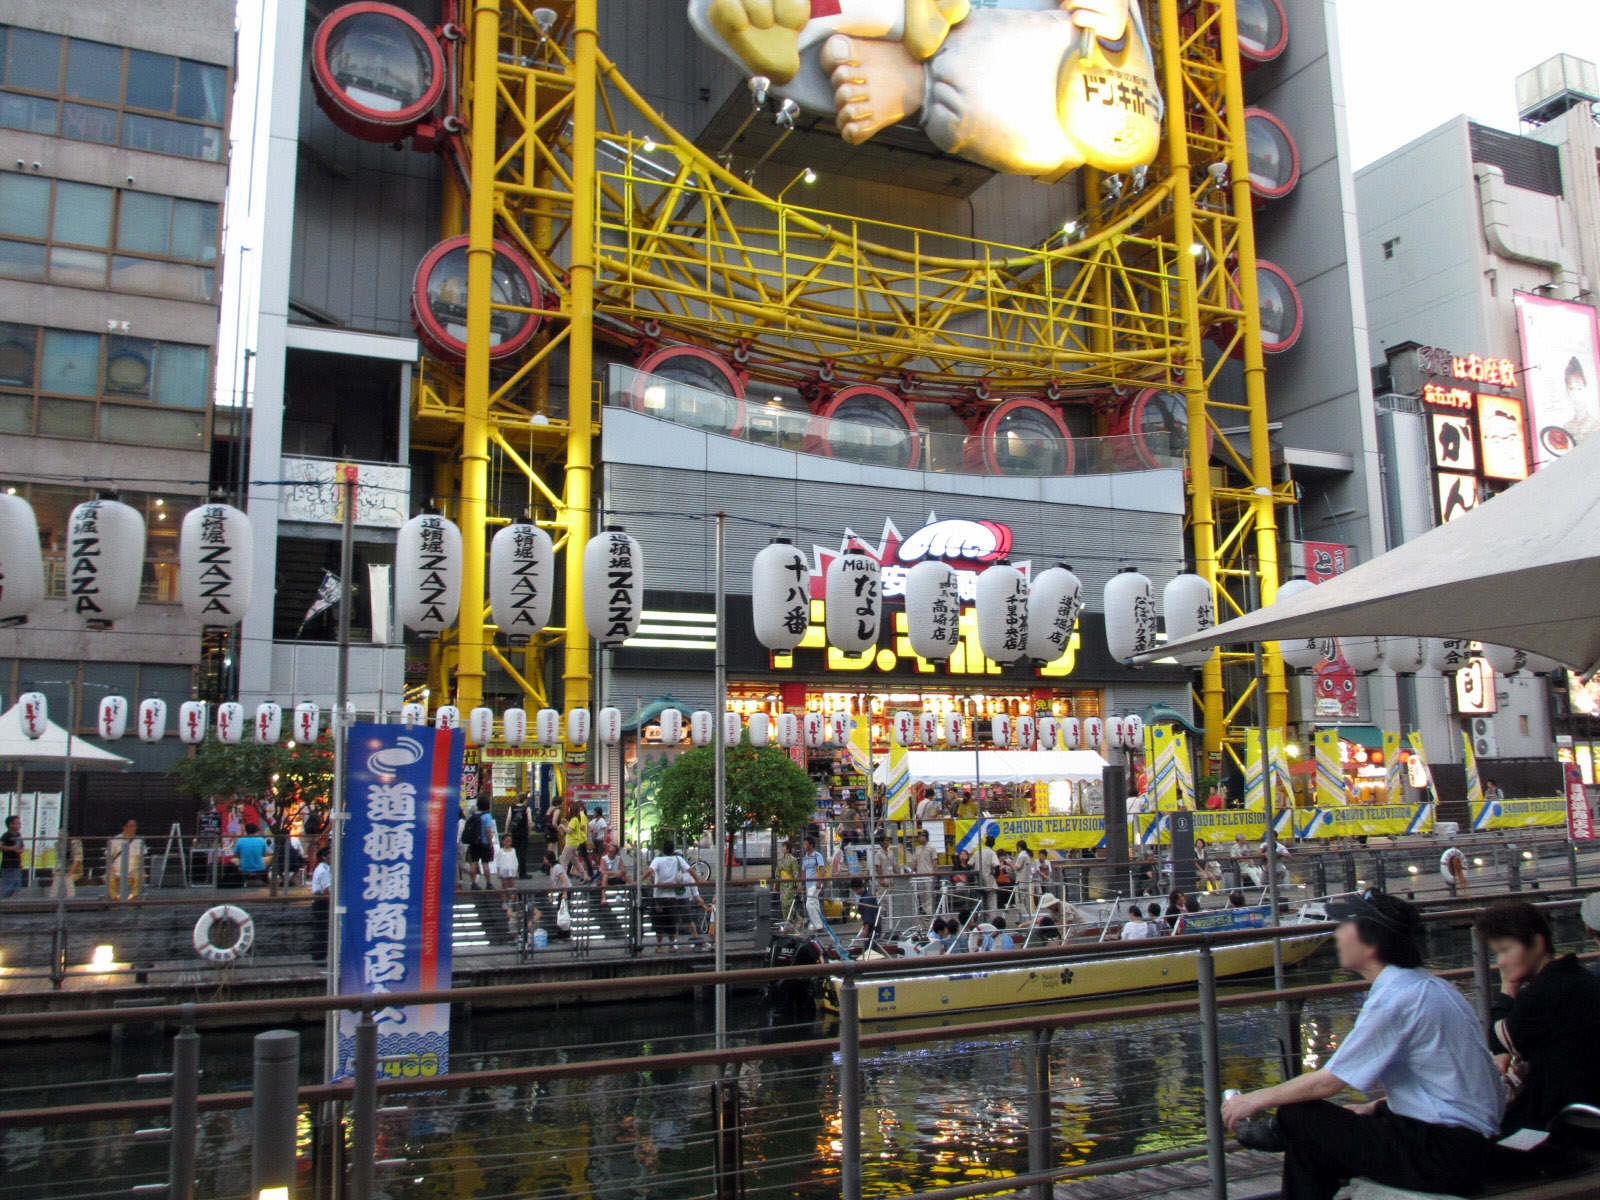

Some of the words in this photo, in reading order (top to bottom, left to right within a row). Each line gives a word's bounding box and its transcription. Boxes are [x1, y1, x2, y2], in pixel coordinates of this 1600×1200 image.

[782, 555, 809, 635] 十八番
[854, 574, 878, 640] たよし
[1003, 594, 1020, 650] 千里中央店
[1003, 819, 1043, 834] 24HOUR
[1045, 817, 1104, 832] TELEVISION
